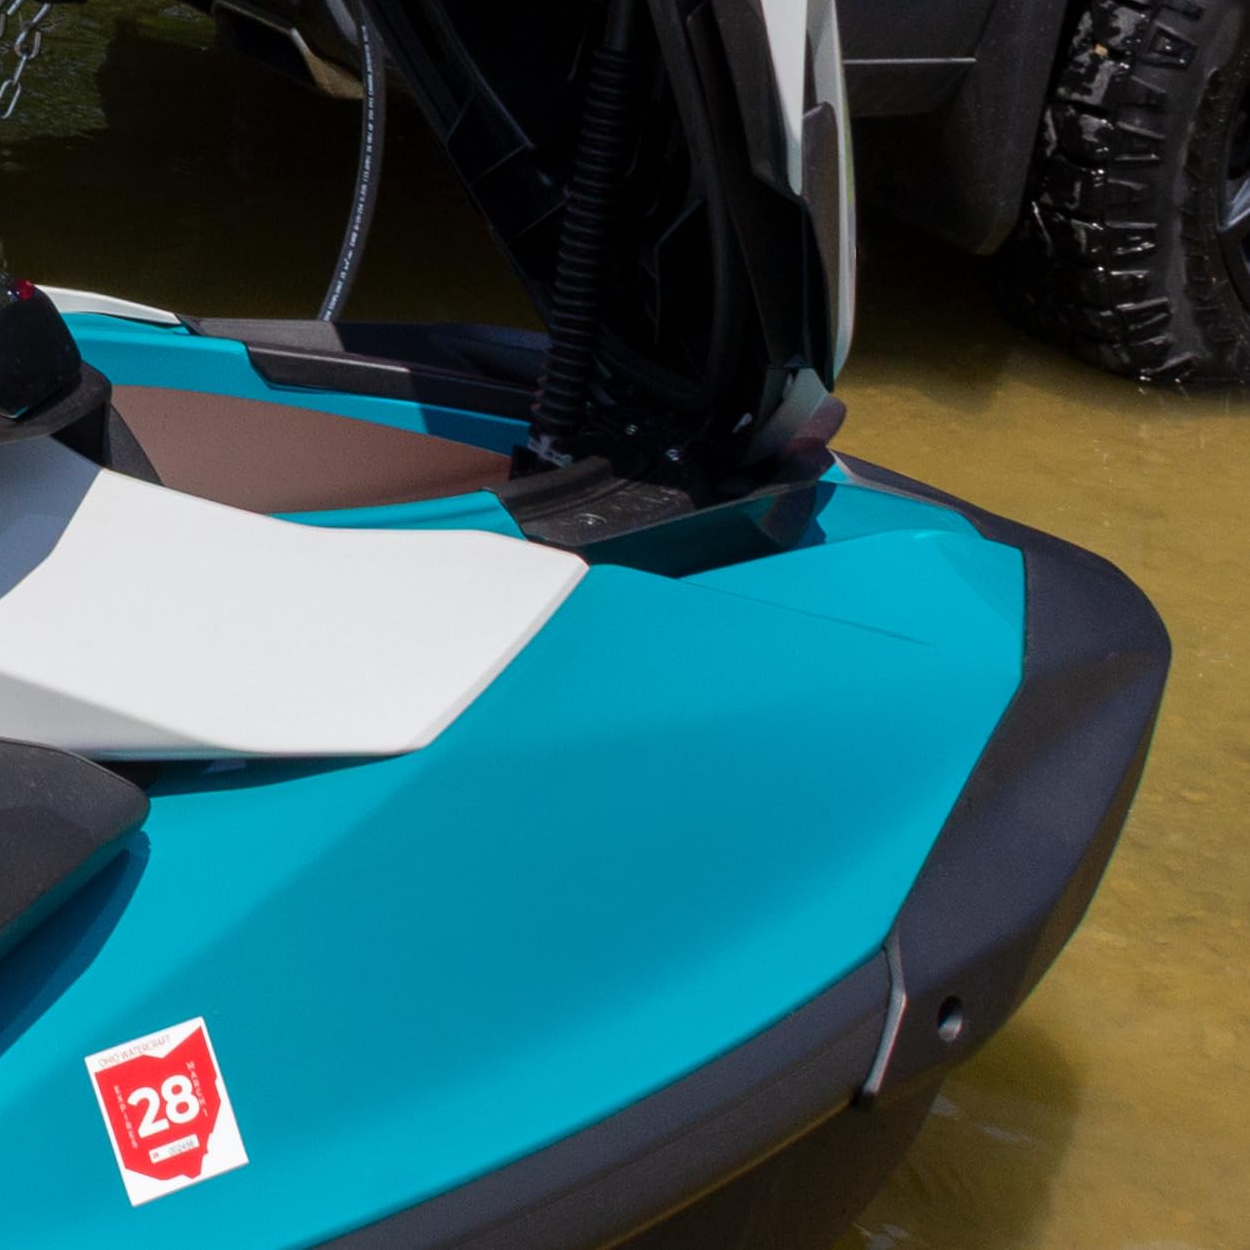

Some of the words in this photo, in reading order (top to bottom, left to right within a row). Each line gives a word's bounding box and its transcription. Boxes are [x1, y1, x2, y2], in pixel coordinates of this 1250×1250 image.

[98, 1052, 120, 1068] OHIO
[121, 1034, 171, 1060] WATERCRAFT
[127, 1074, 200, 1138] 28
[186, 1061, 205, 1107] MARCH
[113, 1085, 138, 1149] EXPIRES
